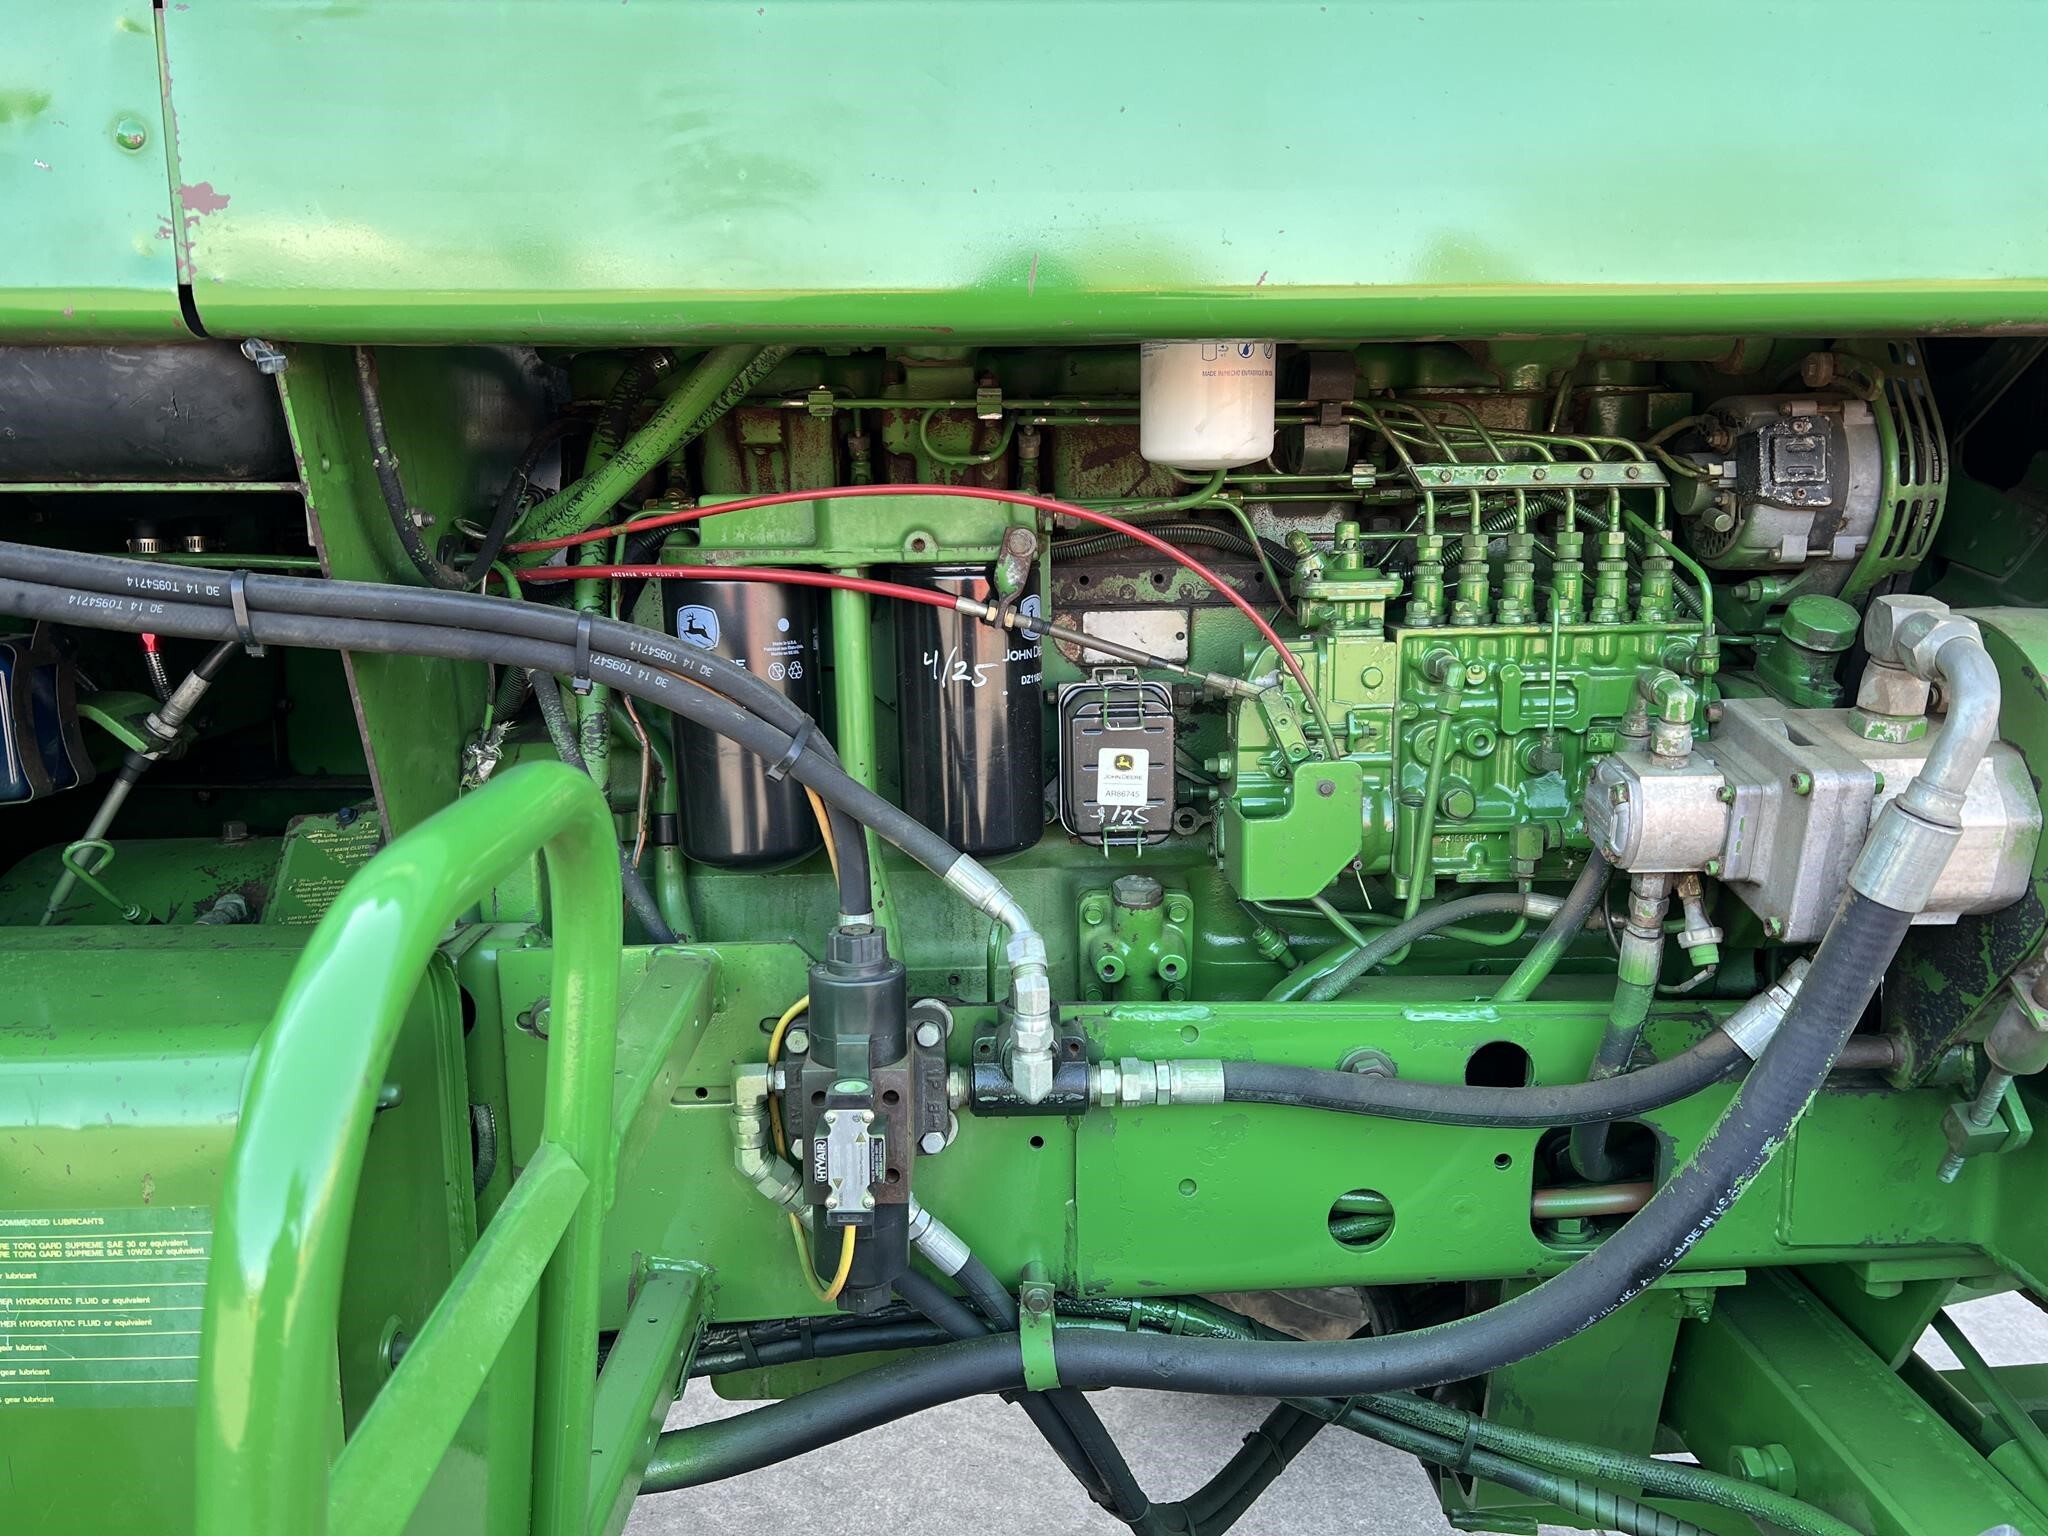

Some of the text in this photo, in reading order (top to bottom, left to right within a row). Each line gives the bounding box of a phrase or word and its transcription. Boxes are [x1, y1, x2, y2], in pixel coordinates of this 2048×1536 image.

[126, 576, 180, 592] T0954714
[186, 583, 199, 594] 14
[68, 594, 123, 610] T0954714
[130, 601, 143, 612] 14
[629, 640, 677, 664] T0954714
[1002, 648, 1033, 662] JOHN
[589, 653, 632, 676] T095471
[682, 657, 695, 669] 14
[923, 646, 1000, 689] 4/25
[637, 669, 650, 681] 14
[1104, 789, 1140, 798] AR86745
[816, 1142, 827, 1180] HYVAIR
[1699, 1215, 1714, 1229] IN
[13, 1242, 36, 1250] TORQ
[39, 1242, 62, 1250] GARD
[65, 1241, 104, 1249] SUPREME
[126, 1240, 136, 1248] 30
[150, 1239, 188, 1249] equivalent
[13, 1250, 36, 1258] TORQ
[39, 1250, 62, 1258] GARD
[65, 1249, 104, 1257] SUPREME
[107, 1248, 124, 1256] SAE
[166, 1247, 205, 1256] equivalent
[16, 1297, 73, 1305] HYDROSTATIC
[112, 1296, 151, 1305] equivalent
[78, 1319, 101, 1327] FLUID
[114, 1319, 153, 1328] equivalent
[19, 1368, 51, 1376] lubricant
